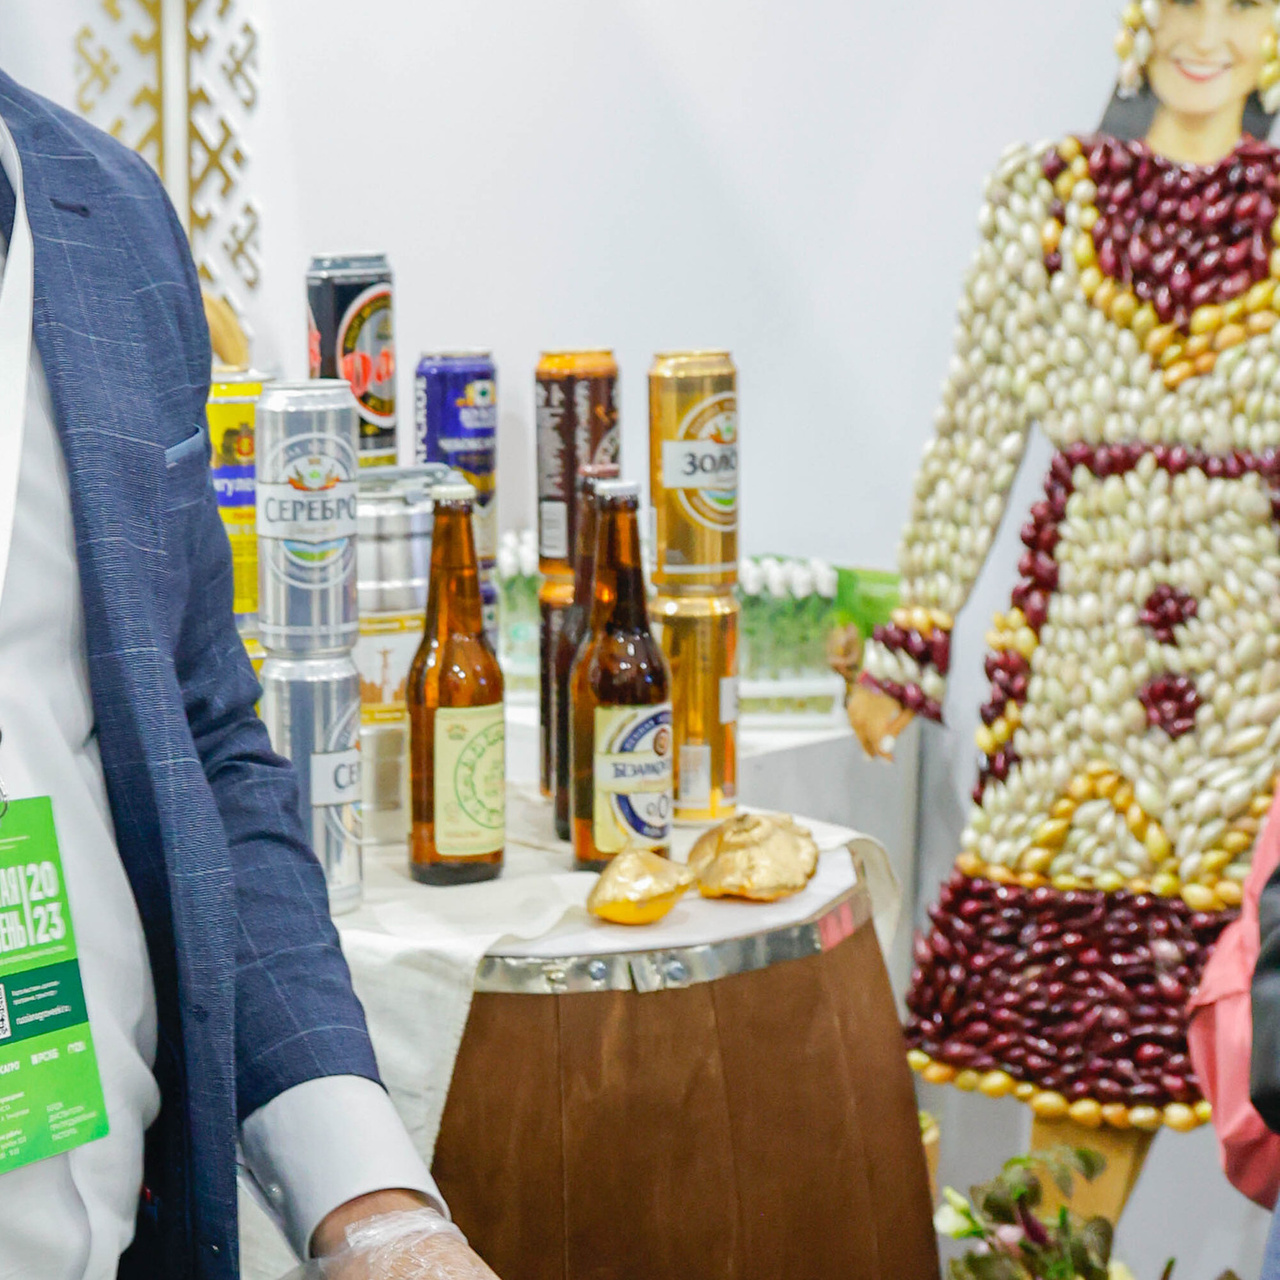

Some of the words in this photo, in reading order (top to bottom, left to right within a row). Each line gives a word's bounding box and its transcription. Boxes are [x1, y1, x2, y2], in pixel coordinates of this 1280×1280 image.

[265, 494, 357, 523] СЕРЕБРО
[26, 861, 59, 901] 20
[33, 902, 66, 944] 23
